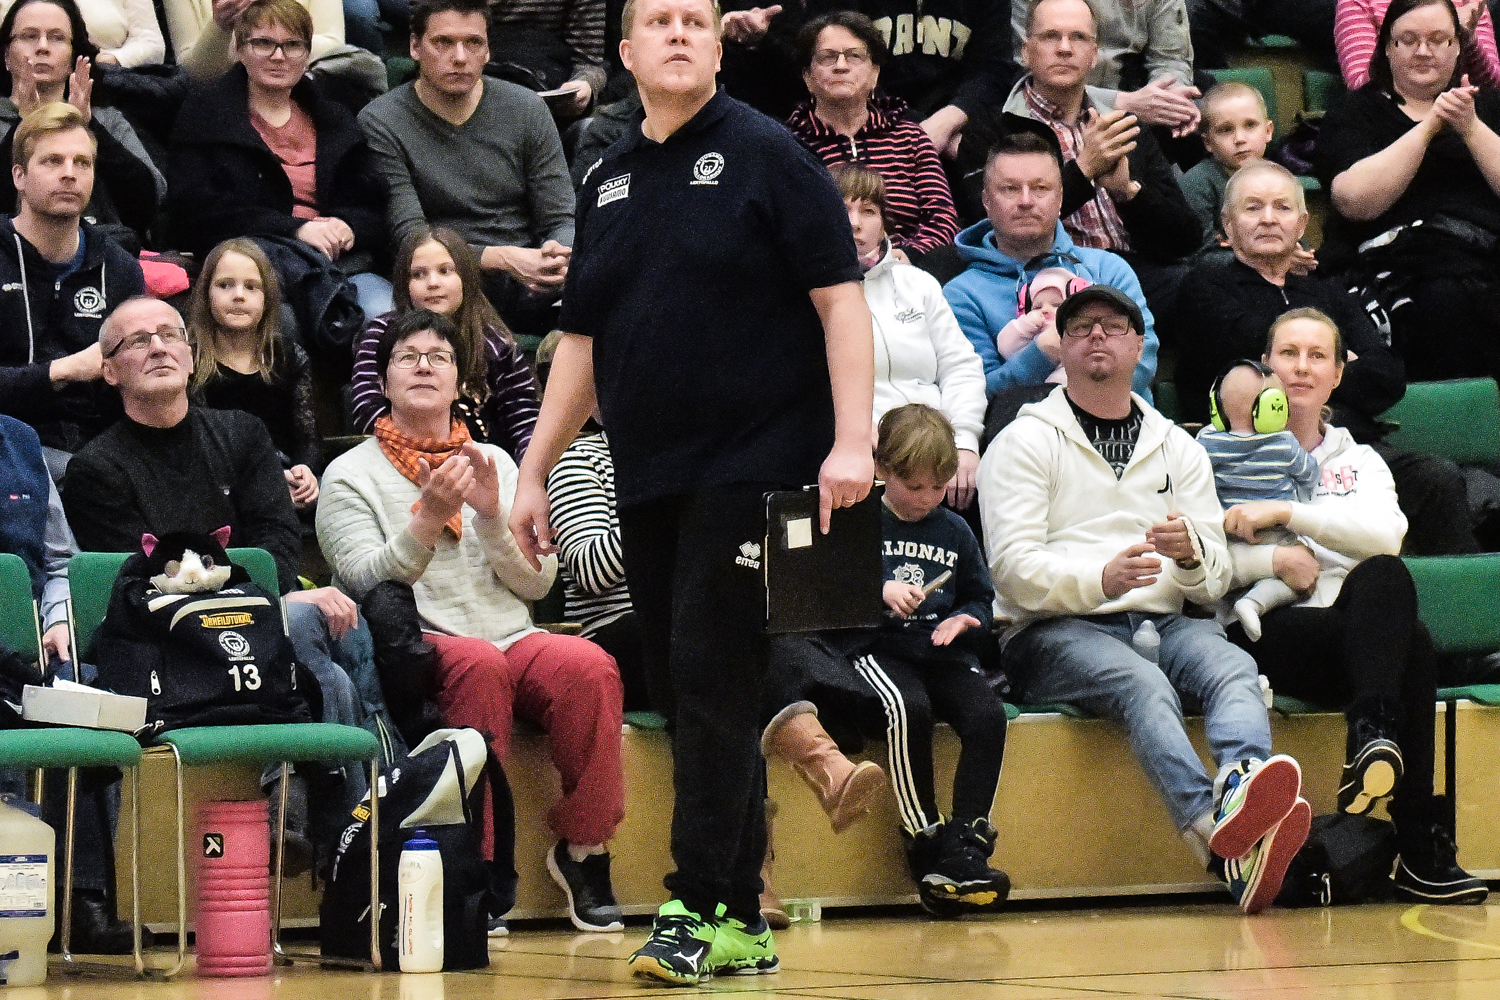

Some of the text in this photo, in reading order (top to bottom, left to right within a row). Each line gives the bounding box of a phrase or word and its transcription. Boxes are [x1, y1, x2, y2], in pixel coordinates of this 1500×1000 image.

[734, 555, 761, 570] errea
[882, 540, 959, 568] IJONAT
[228, 664, 262, 692] 13
